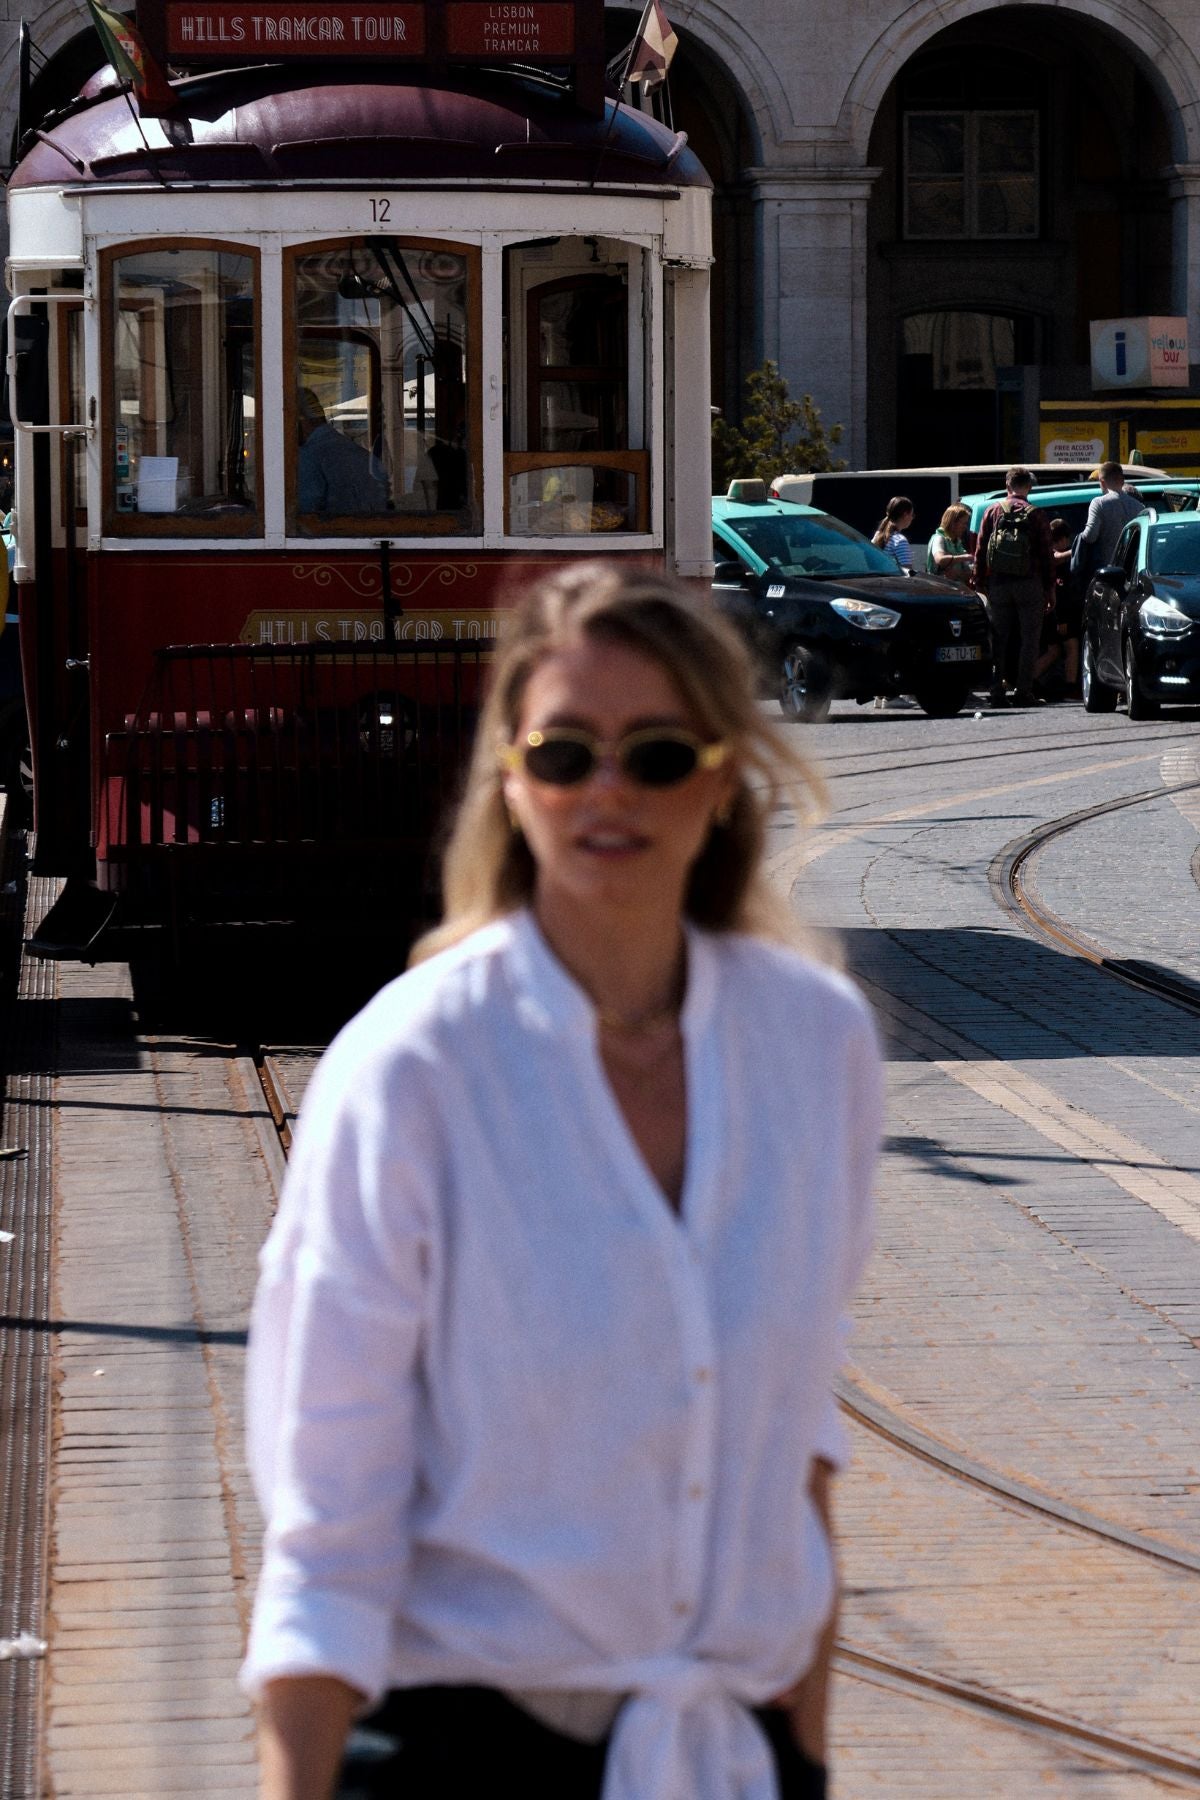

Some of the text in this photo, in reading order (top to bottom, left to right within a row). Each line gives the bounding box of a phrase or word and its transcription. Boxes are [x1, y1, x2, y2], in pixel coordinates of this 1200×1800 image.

[489, 6, 534, 18] LISBON
[181, 17, 407, 41] HILLS TRAMCAR TOUR
[484, 23, 540, 35] PREMIUM
[484, 39, 540, 52] TRAMCAR
[369, 198, 391, 222] 12
